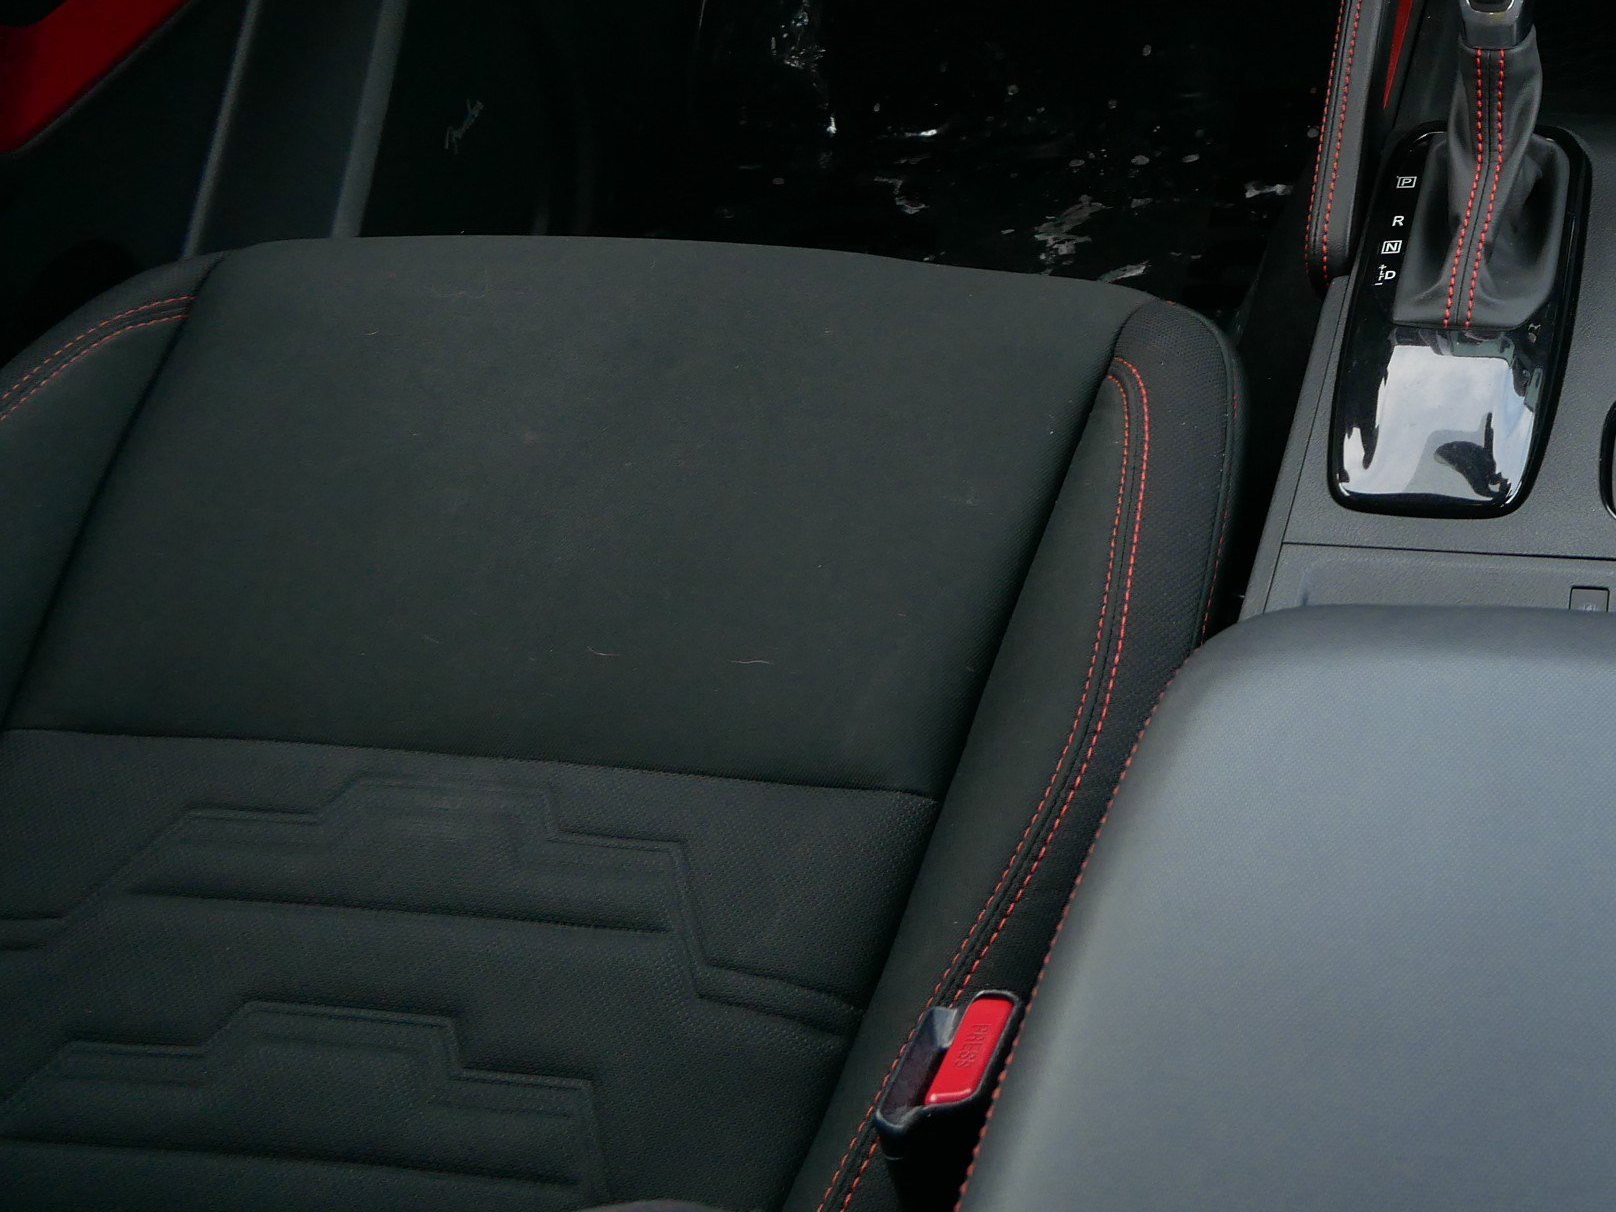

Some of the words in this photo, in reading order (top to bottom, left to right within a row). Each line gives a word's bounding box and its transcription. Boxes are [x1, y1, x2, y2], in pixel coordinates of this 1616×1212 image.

[1401, 178, 1412, 186] P
[1392, 215, 1404, 227] R
[1385, 243, 1398, 251] N
[1384, 270, 1396, 280] D
